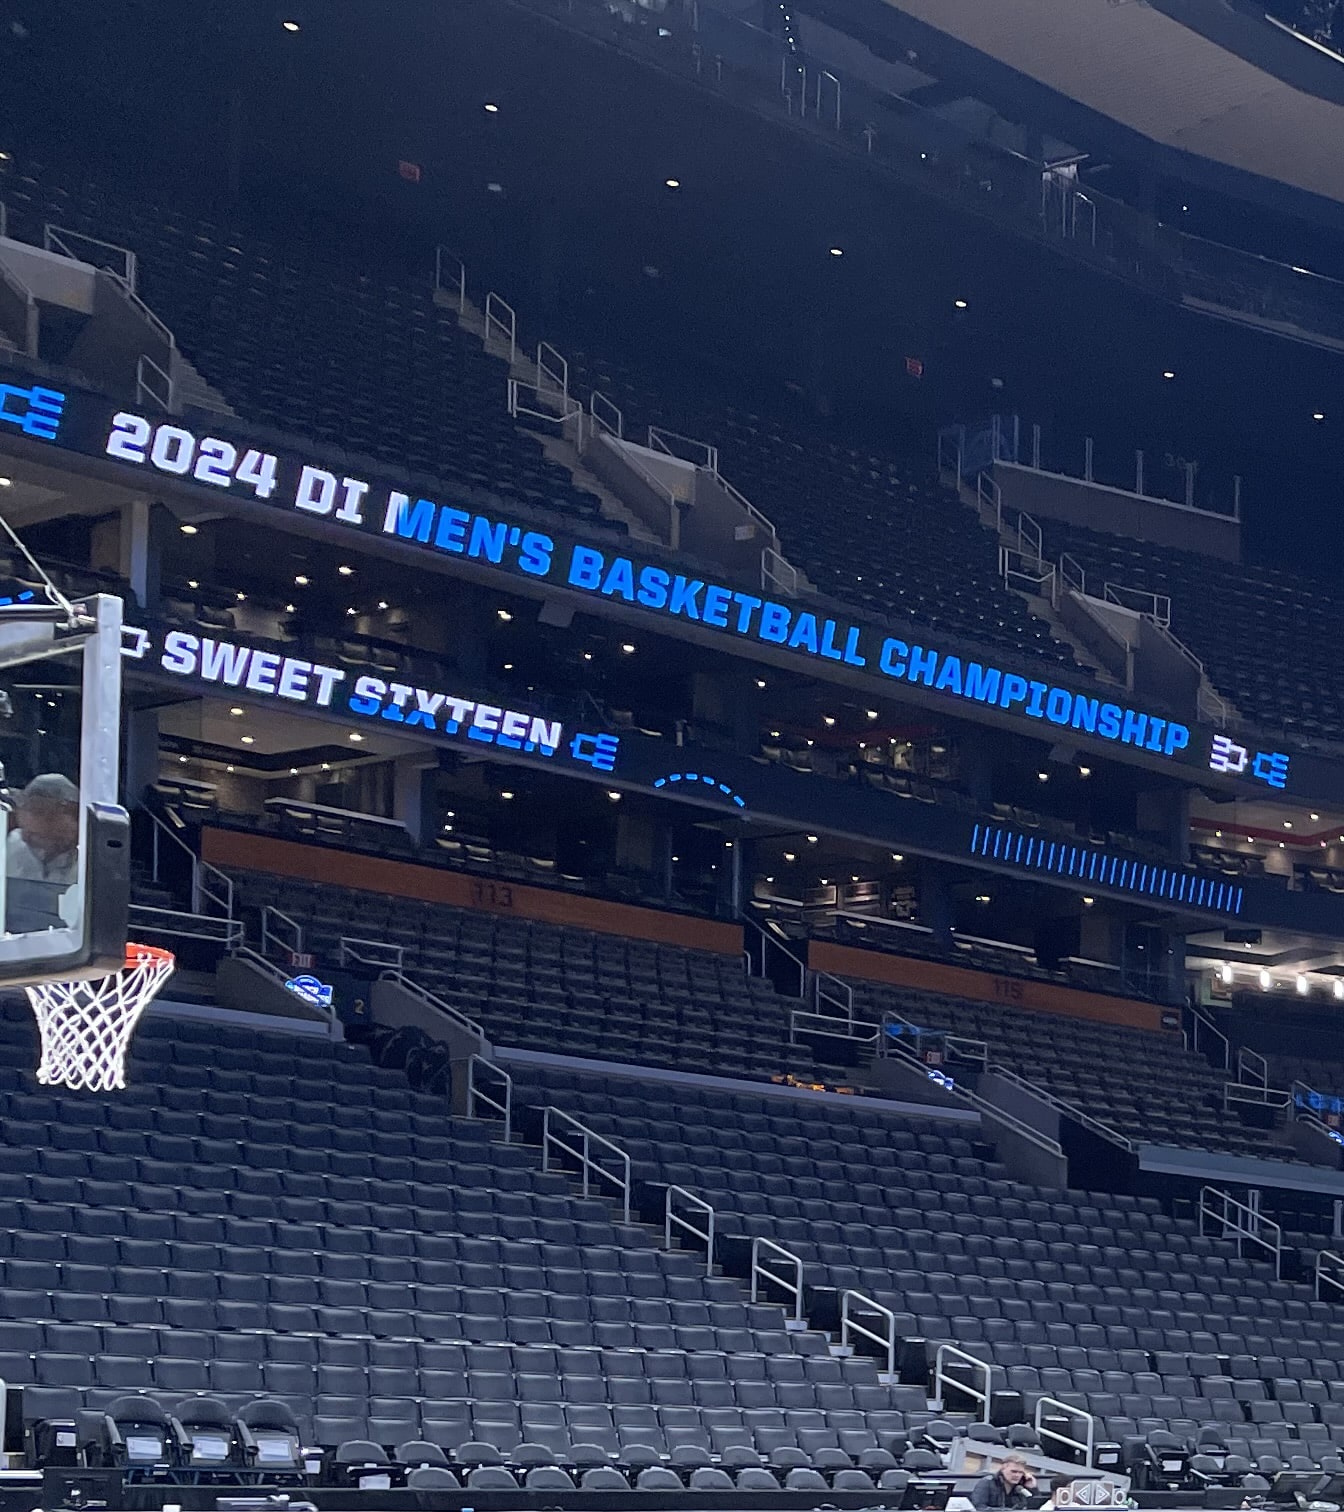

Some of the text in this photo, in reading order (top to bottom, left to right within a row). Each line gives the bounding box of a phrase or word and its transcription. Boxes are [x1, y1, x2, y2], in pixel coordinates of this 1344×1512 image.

[105, 411, 1189, 756] 2024 DI MEN'S BASKETBALL CHAMPIONSHIP
[162, 630, 562, 755] SWEET SIXTEEN
